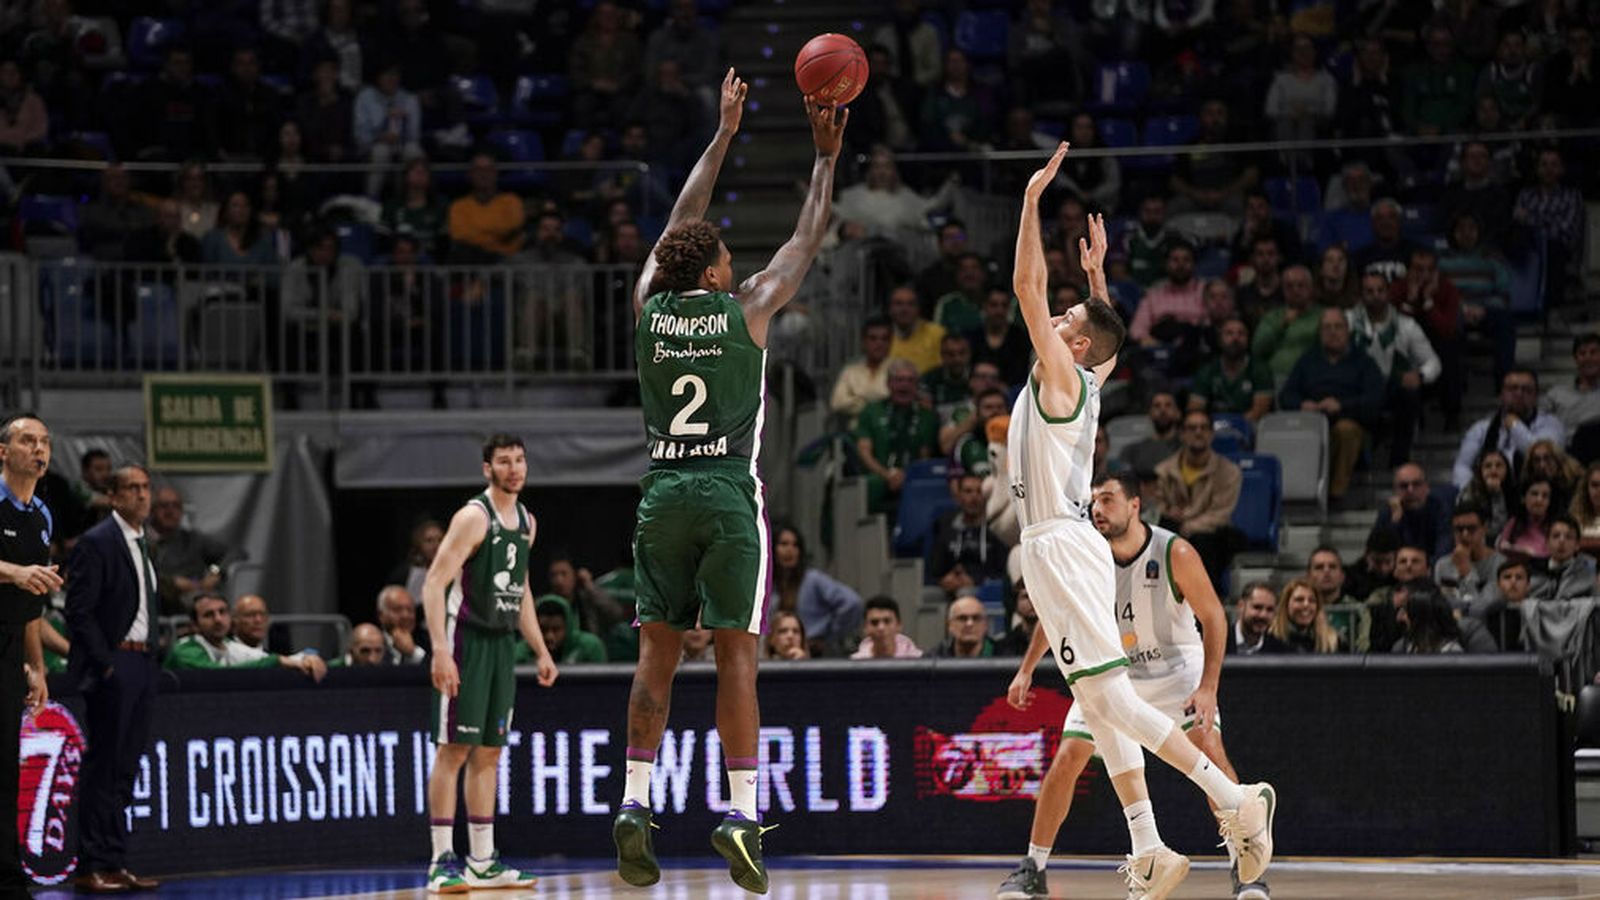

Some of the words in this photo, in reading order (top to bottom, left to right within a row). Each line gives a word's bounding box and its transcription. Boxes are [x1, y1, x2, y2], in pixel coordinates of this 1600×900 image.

[650, 312, 729, 337] THOMPSON
[160, 395, 222, 423] SALIDA
[233, 396, 257, 424] DE
[669, 374, 709, 436] 2
[156, 427, 264, 455] EMERGENCIA
[1059, 637, 1076, 665] 6
[187, 731, 400, 828] CROISSANT
[497, 729, 612, 815] THE
